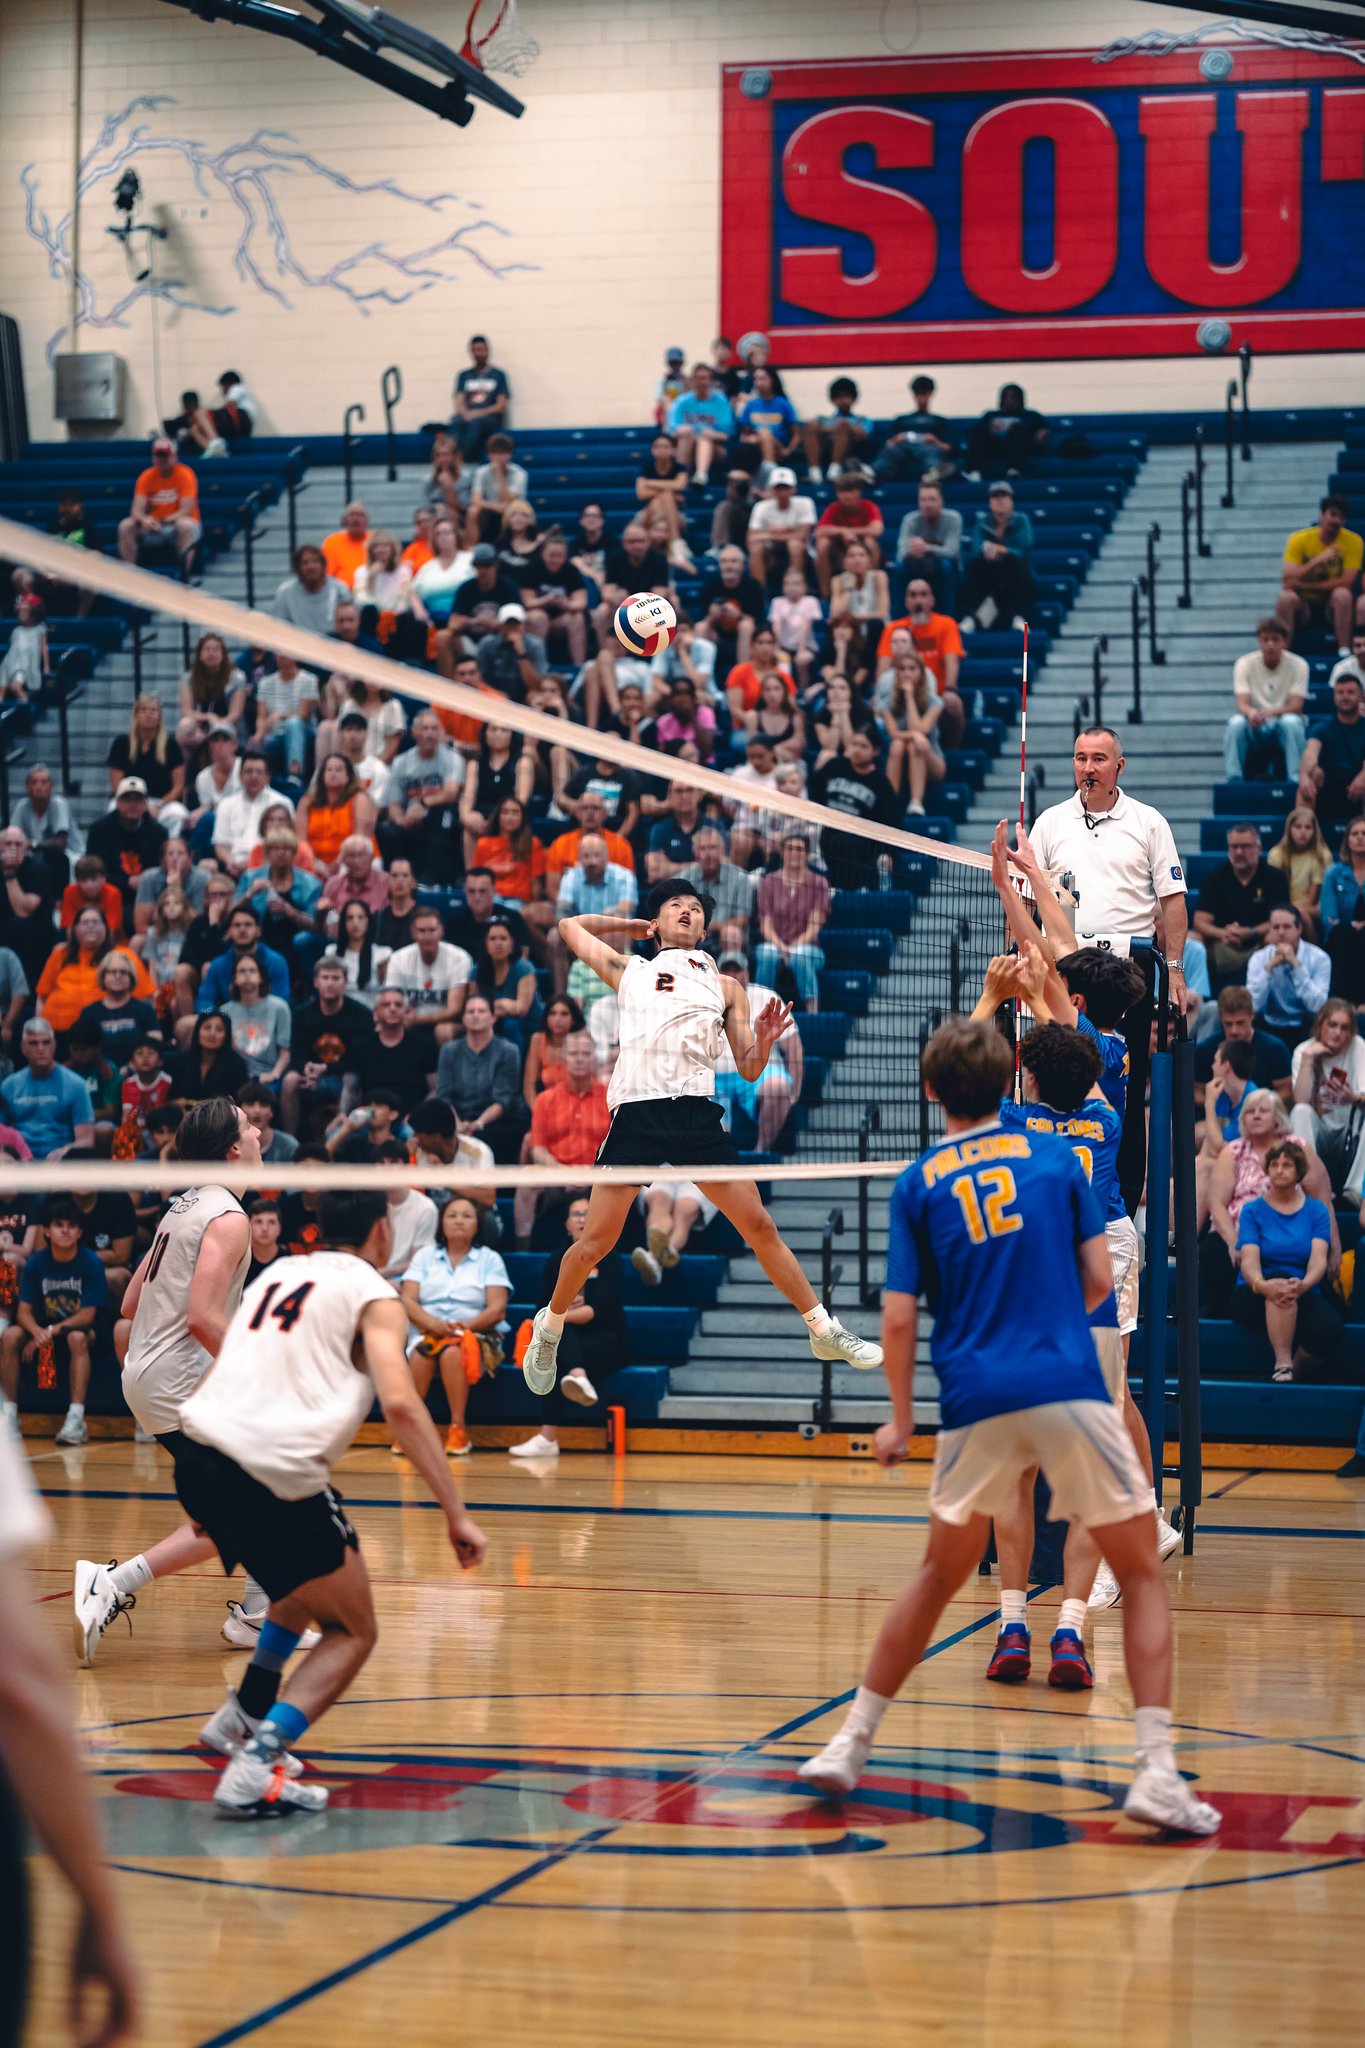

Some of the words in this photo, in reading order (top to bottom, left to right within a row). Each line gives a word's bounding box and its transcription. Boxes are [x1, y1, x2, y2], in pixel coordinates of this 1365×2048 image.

[655, 972, 675, 992] 2
[922, 1133, 1031, 1189] FALCONS
[951, 1165, 1024, 1244] 12
[248, 1281, 316, 1332] 14
